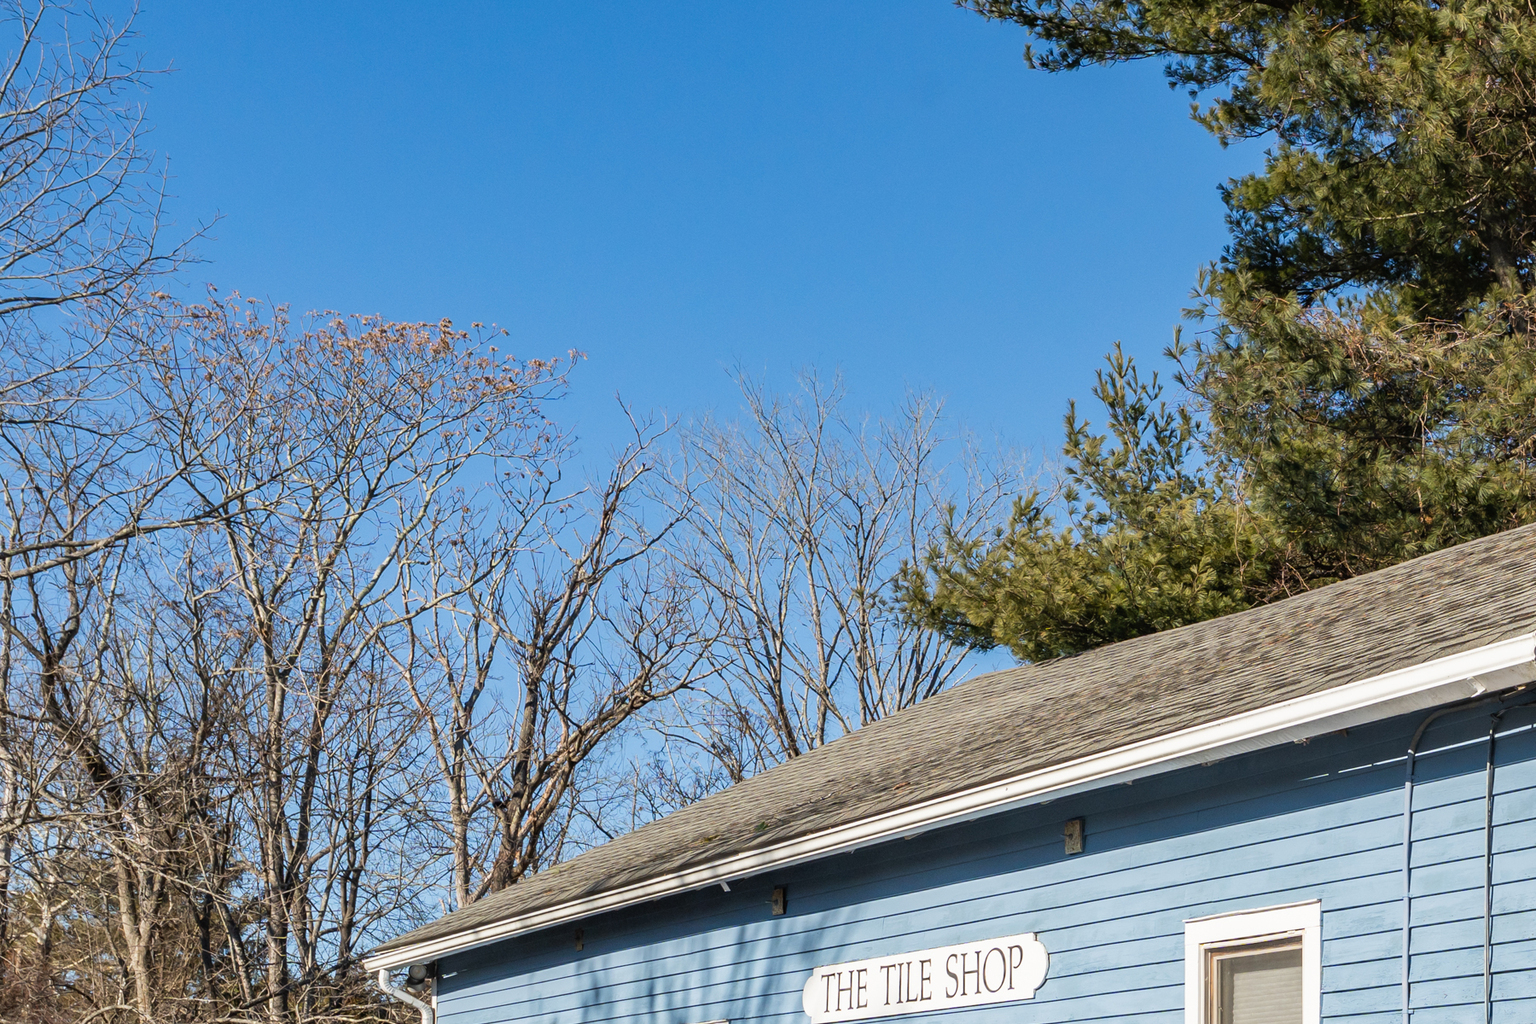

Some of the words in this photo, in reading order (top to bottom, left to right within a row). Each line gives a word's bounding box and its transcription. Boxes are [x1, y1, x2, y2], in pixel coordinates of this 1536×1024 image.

[821, 968, 868, 1013] THE
[880, 958, 932, 1006] TILE
[945, 944, 1023, 999] SHOP
